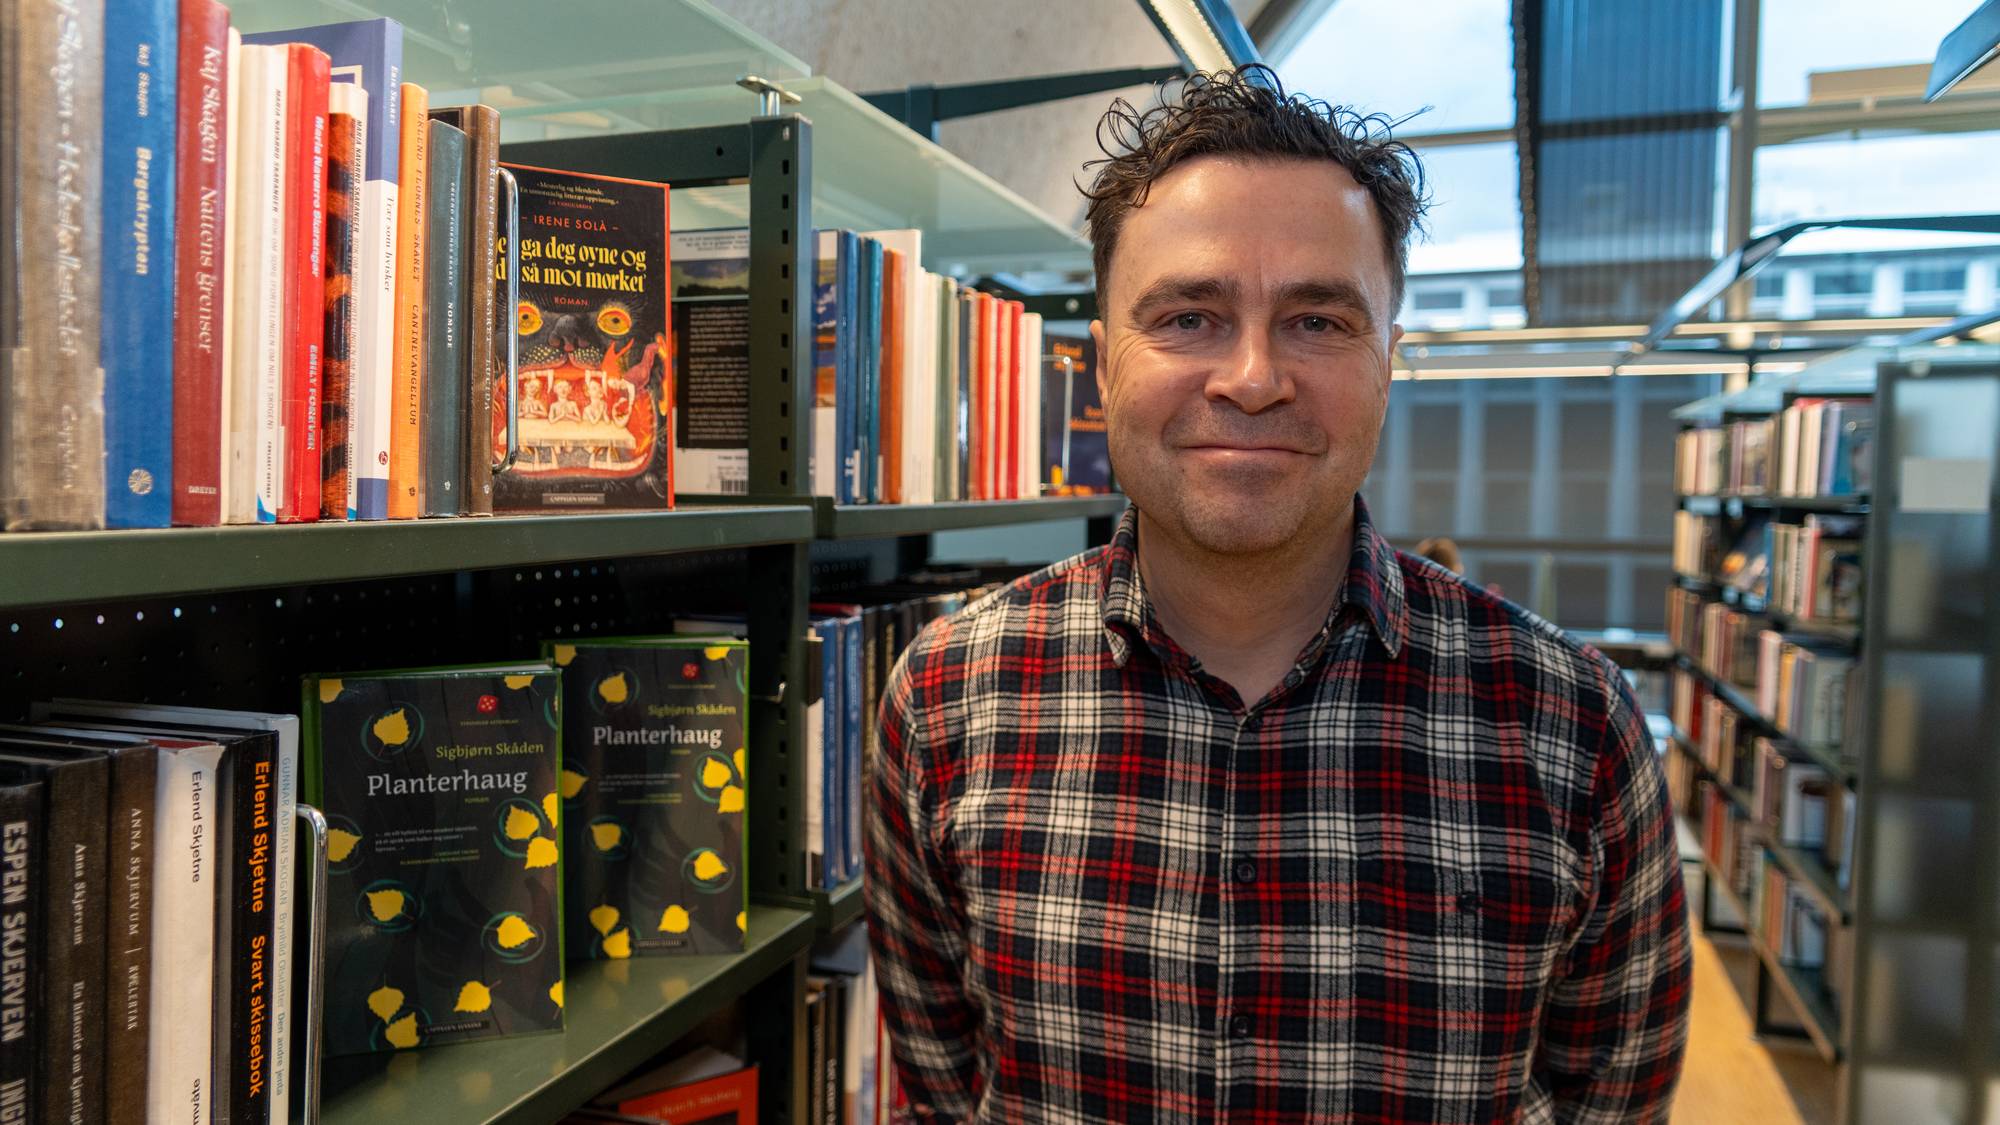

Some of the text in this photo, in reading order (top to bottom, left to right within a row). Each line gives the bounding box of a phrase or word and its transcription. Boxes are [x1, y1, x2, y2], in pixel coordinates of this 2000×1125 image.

[199, 46, 222, 164] Kaj Skagen
[313, 116, 325, 155] Maria
[312, 155, 323, 209] Navarro
[133, 147, 152, 276] Bergakrypten
[533, 214, 608, 232] IRENE SOLÀ
[385, 226, 393, 249] som
[412, 233, 421, 283] SKARET
[521, 239, 542, 262] ga
[545, 236, 576, 266] deg
[621, 249, 647, 272] og
[195, 186, 218, 355] Nattens grenser
[384, 250, 393, 293] hvisker
[521, 262, 541, 284] så
[544, 268, 582, 287] mot
[553, 296, 590, 307] ROMAN
[409, 303, 420, 426] CANINEVANGELIUM
[435, 741, 545, 761] Sigbjørn Skåden
[593, 725, 724, 750] Planterhaug
[281, 757, 292, 807] GUNNAR
[367, 768, 529, 797] Planterhaug
[190, 770, 203, 884] Erlend Skjetne
[248, 760, 271, 913] Erlend Skjetne
[279, 810, 290, 855] ADRIAN
[72, 843, 87, 946] Anna Skjervum
[126, 807, 143, 936] ANNA SKJERVUM
[278, 857, 289, 906] SKOGAN
[0, 820, 28, 1125] ESPEN SKJERVEN ING
[127, 964, 139, 1031] KVELERTAK
[249, 934, 266, 1099] Svart skissebok
[71, 1052, 81, 1074] om
